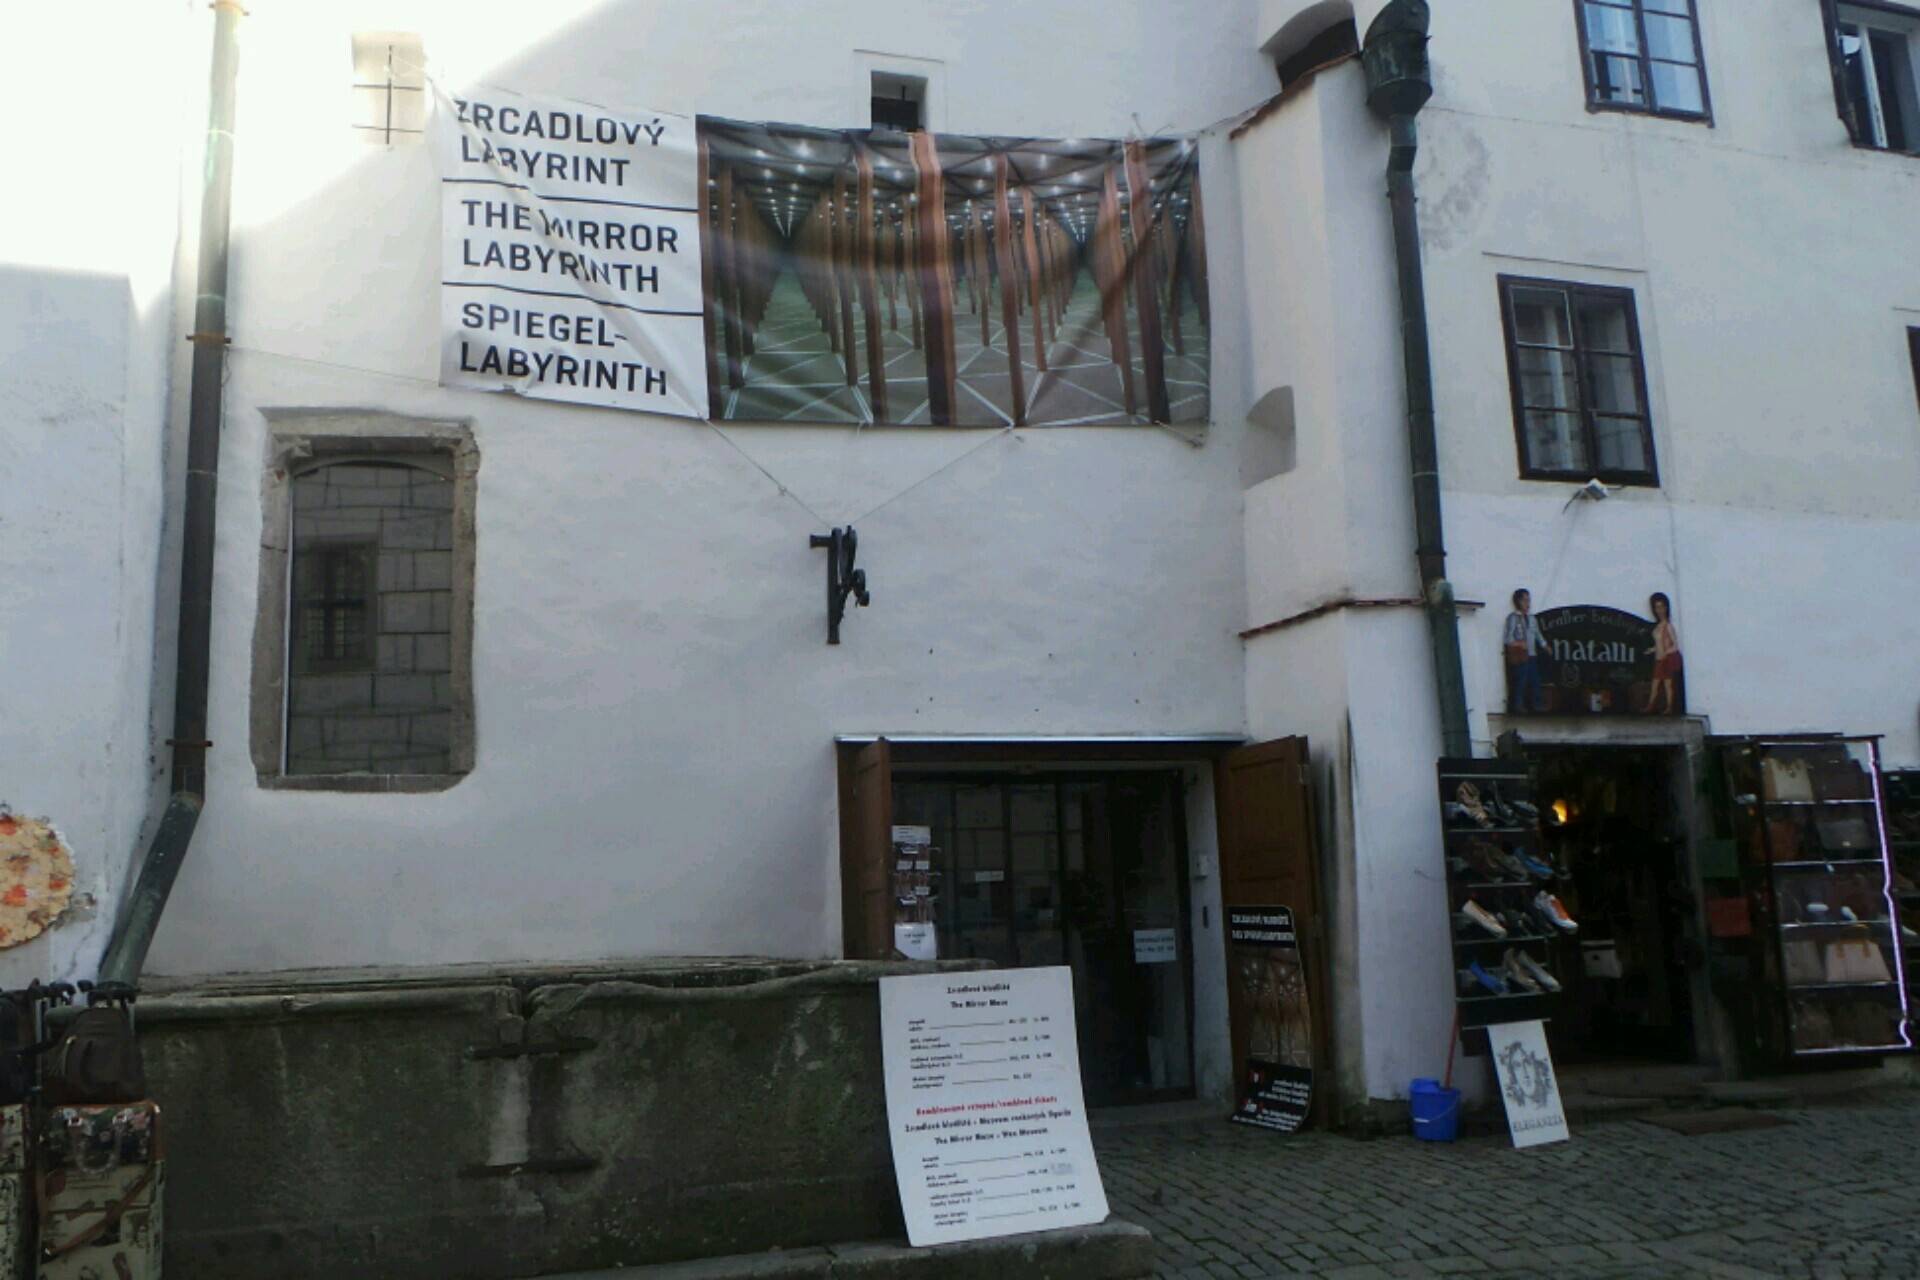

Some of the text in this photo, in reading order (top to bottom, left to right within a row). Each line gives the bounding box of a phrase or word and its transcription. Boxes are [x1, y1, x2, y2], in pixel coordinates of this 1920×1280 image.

[454, 99, 665, 147] ZRCADLOVÝ
[461, 135, 630, 186] LABYRINT
[461, 200, 679, 253] THE MIRROR
[463, 239, 659, 293] LABYRINTH
[461, 302, 628, 348] SPIEGEL-
[459, 341, 667, 396] LABYRINTH
